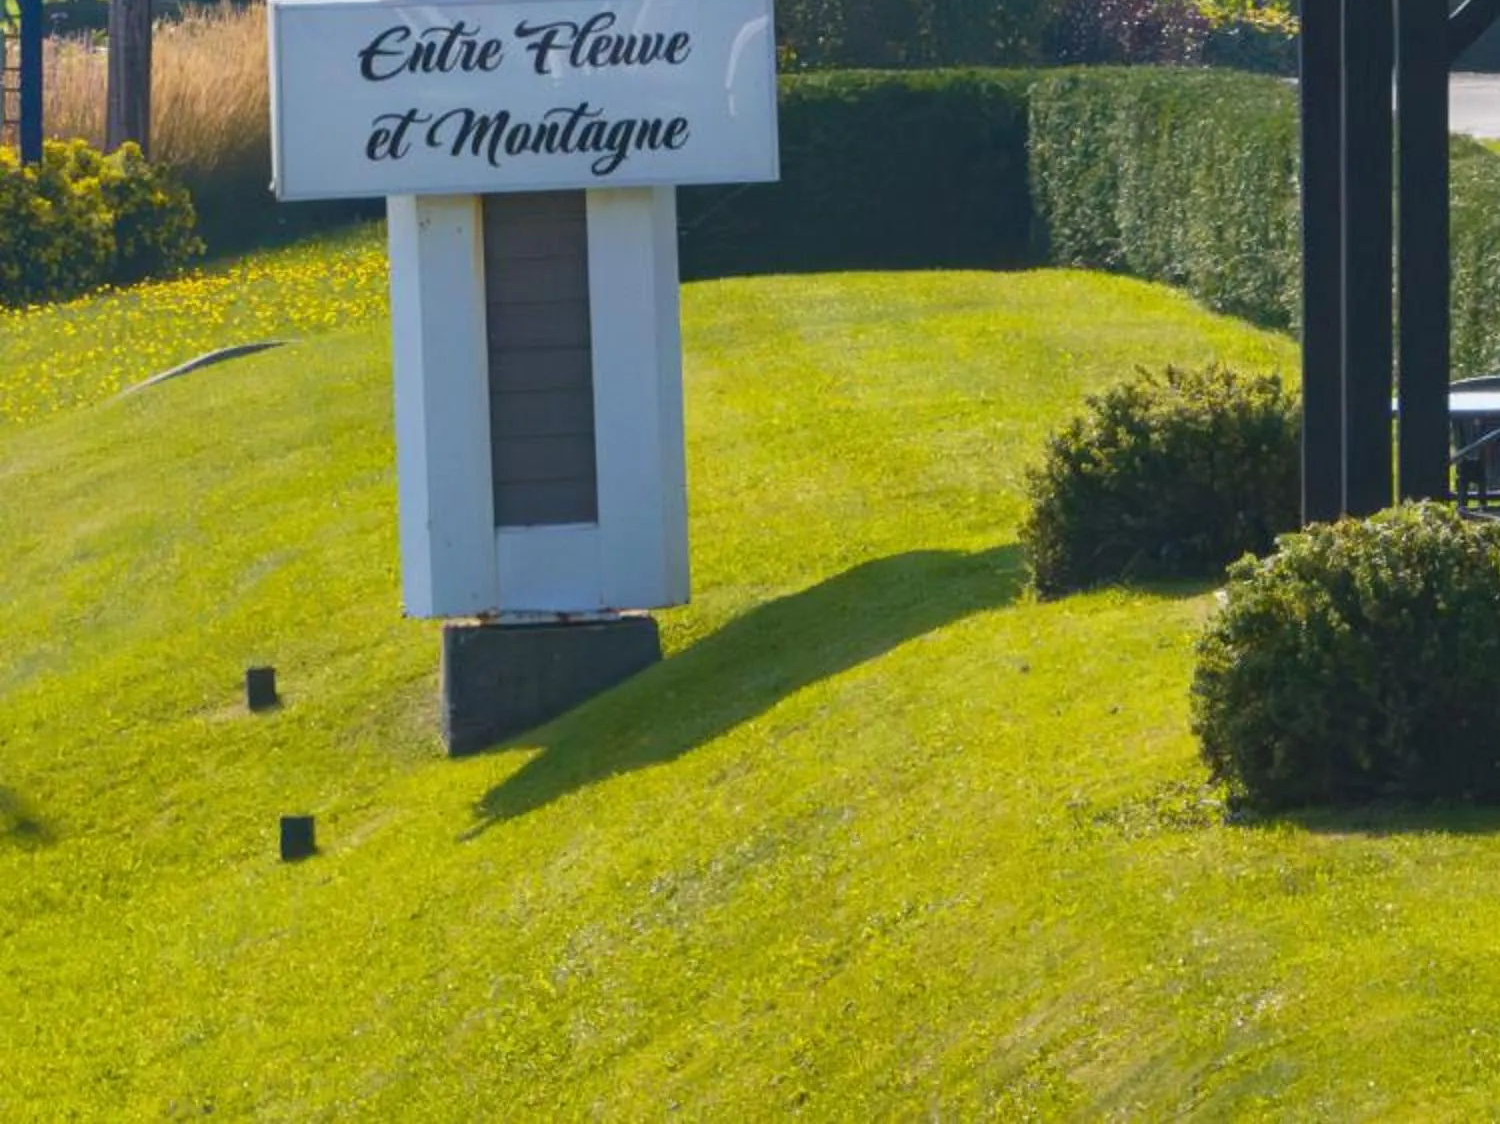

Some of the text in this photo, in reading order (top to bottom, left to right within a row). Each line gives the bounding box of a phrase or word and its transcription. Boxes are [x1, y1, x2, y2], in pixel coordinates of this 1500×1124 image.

[358, 12, 692, 81] Entre Fleuve
[365, 102, 690, 176] et Montagne
